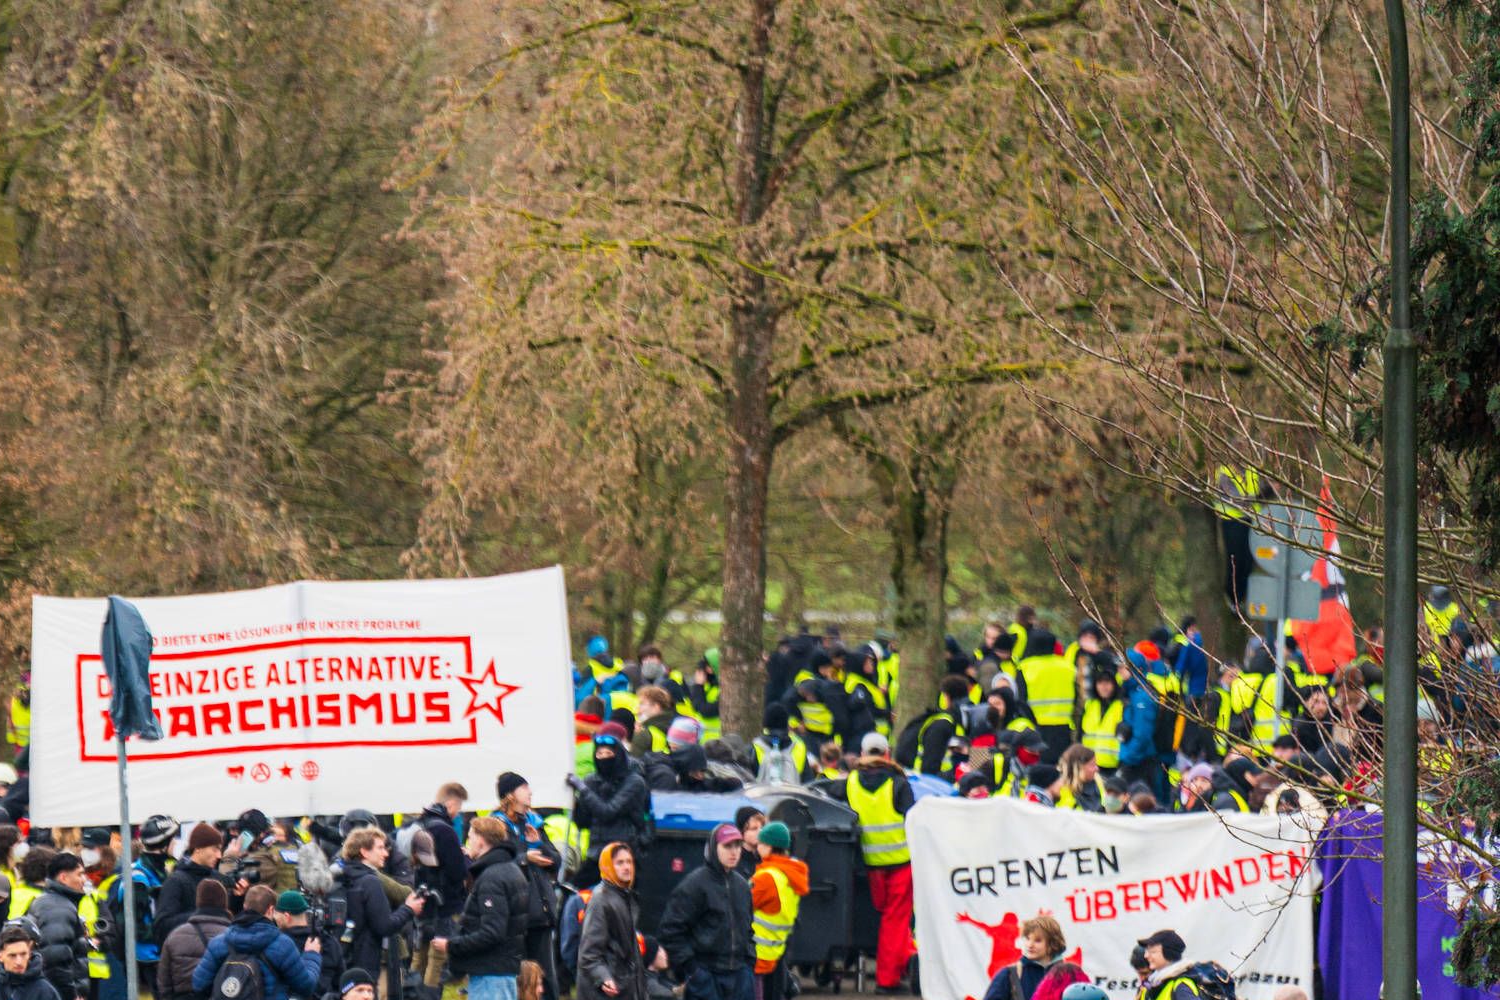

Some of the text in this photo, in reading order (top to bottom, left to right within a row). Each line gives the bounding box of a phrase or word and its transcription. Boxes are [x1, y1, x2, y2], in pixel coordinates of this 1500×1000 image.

[162, 634, 196, 648] BIETET
[199, 632, 232, 645] KEINE
[234, 622, 292, 642] LÖSUNGEN
[296, 618, 316, 632] FÜR
[318, 618, 360, 631] UNSERE
[363, 619, 421, 631] PROBLEME
[151, 664, 254, 698] EINZIGE
[266, 655, 452, 688] ALTERNATIVE:
[100, 692, 450, 741] ARCHISMUS
[950, 845, 1120, 896] GRENZEN
[1065, 847, 1311, 923] ÜBERWINDEN
